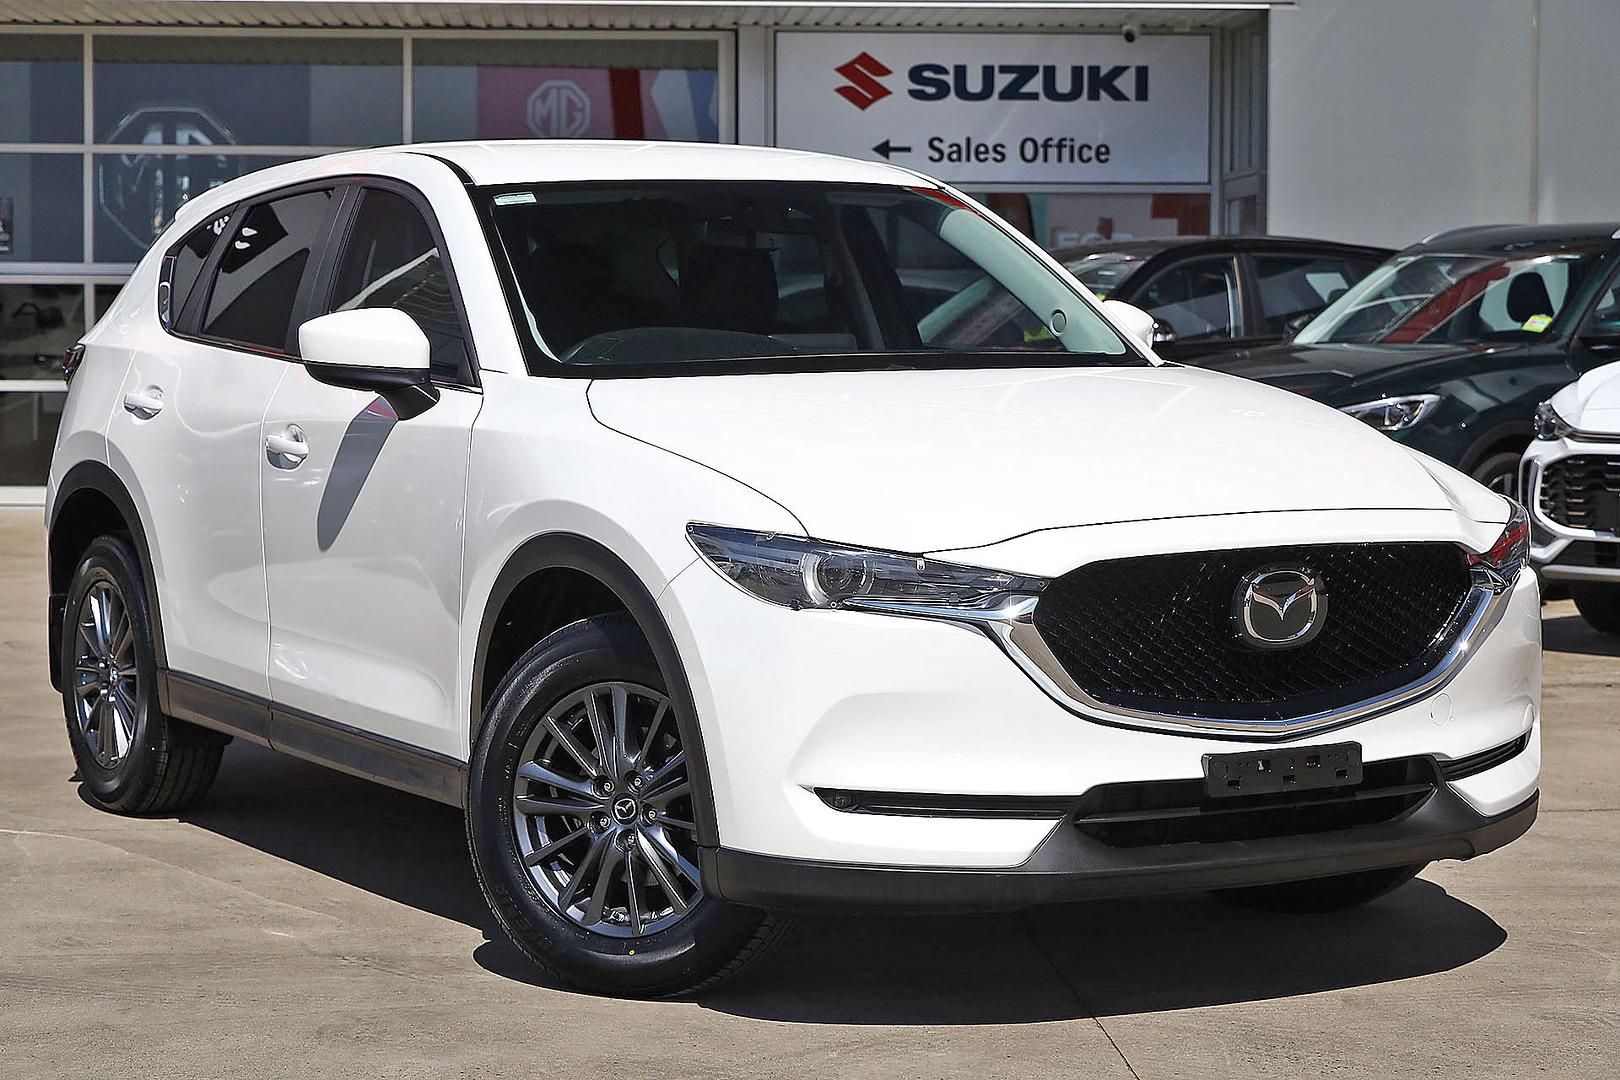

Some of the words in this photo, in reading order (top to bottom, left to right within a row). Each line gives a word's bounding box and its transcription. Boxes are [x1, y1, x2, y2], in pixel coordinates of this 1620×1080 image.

[907, 63, 1149, 102] SUZUKI
[531, 86, 585, 138] MG
[927, 136, 1006, 164] Sales
[1019, 136, 1111, 164] Office
